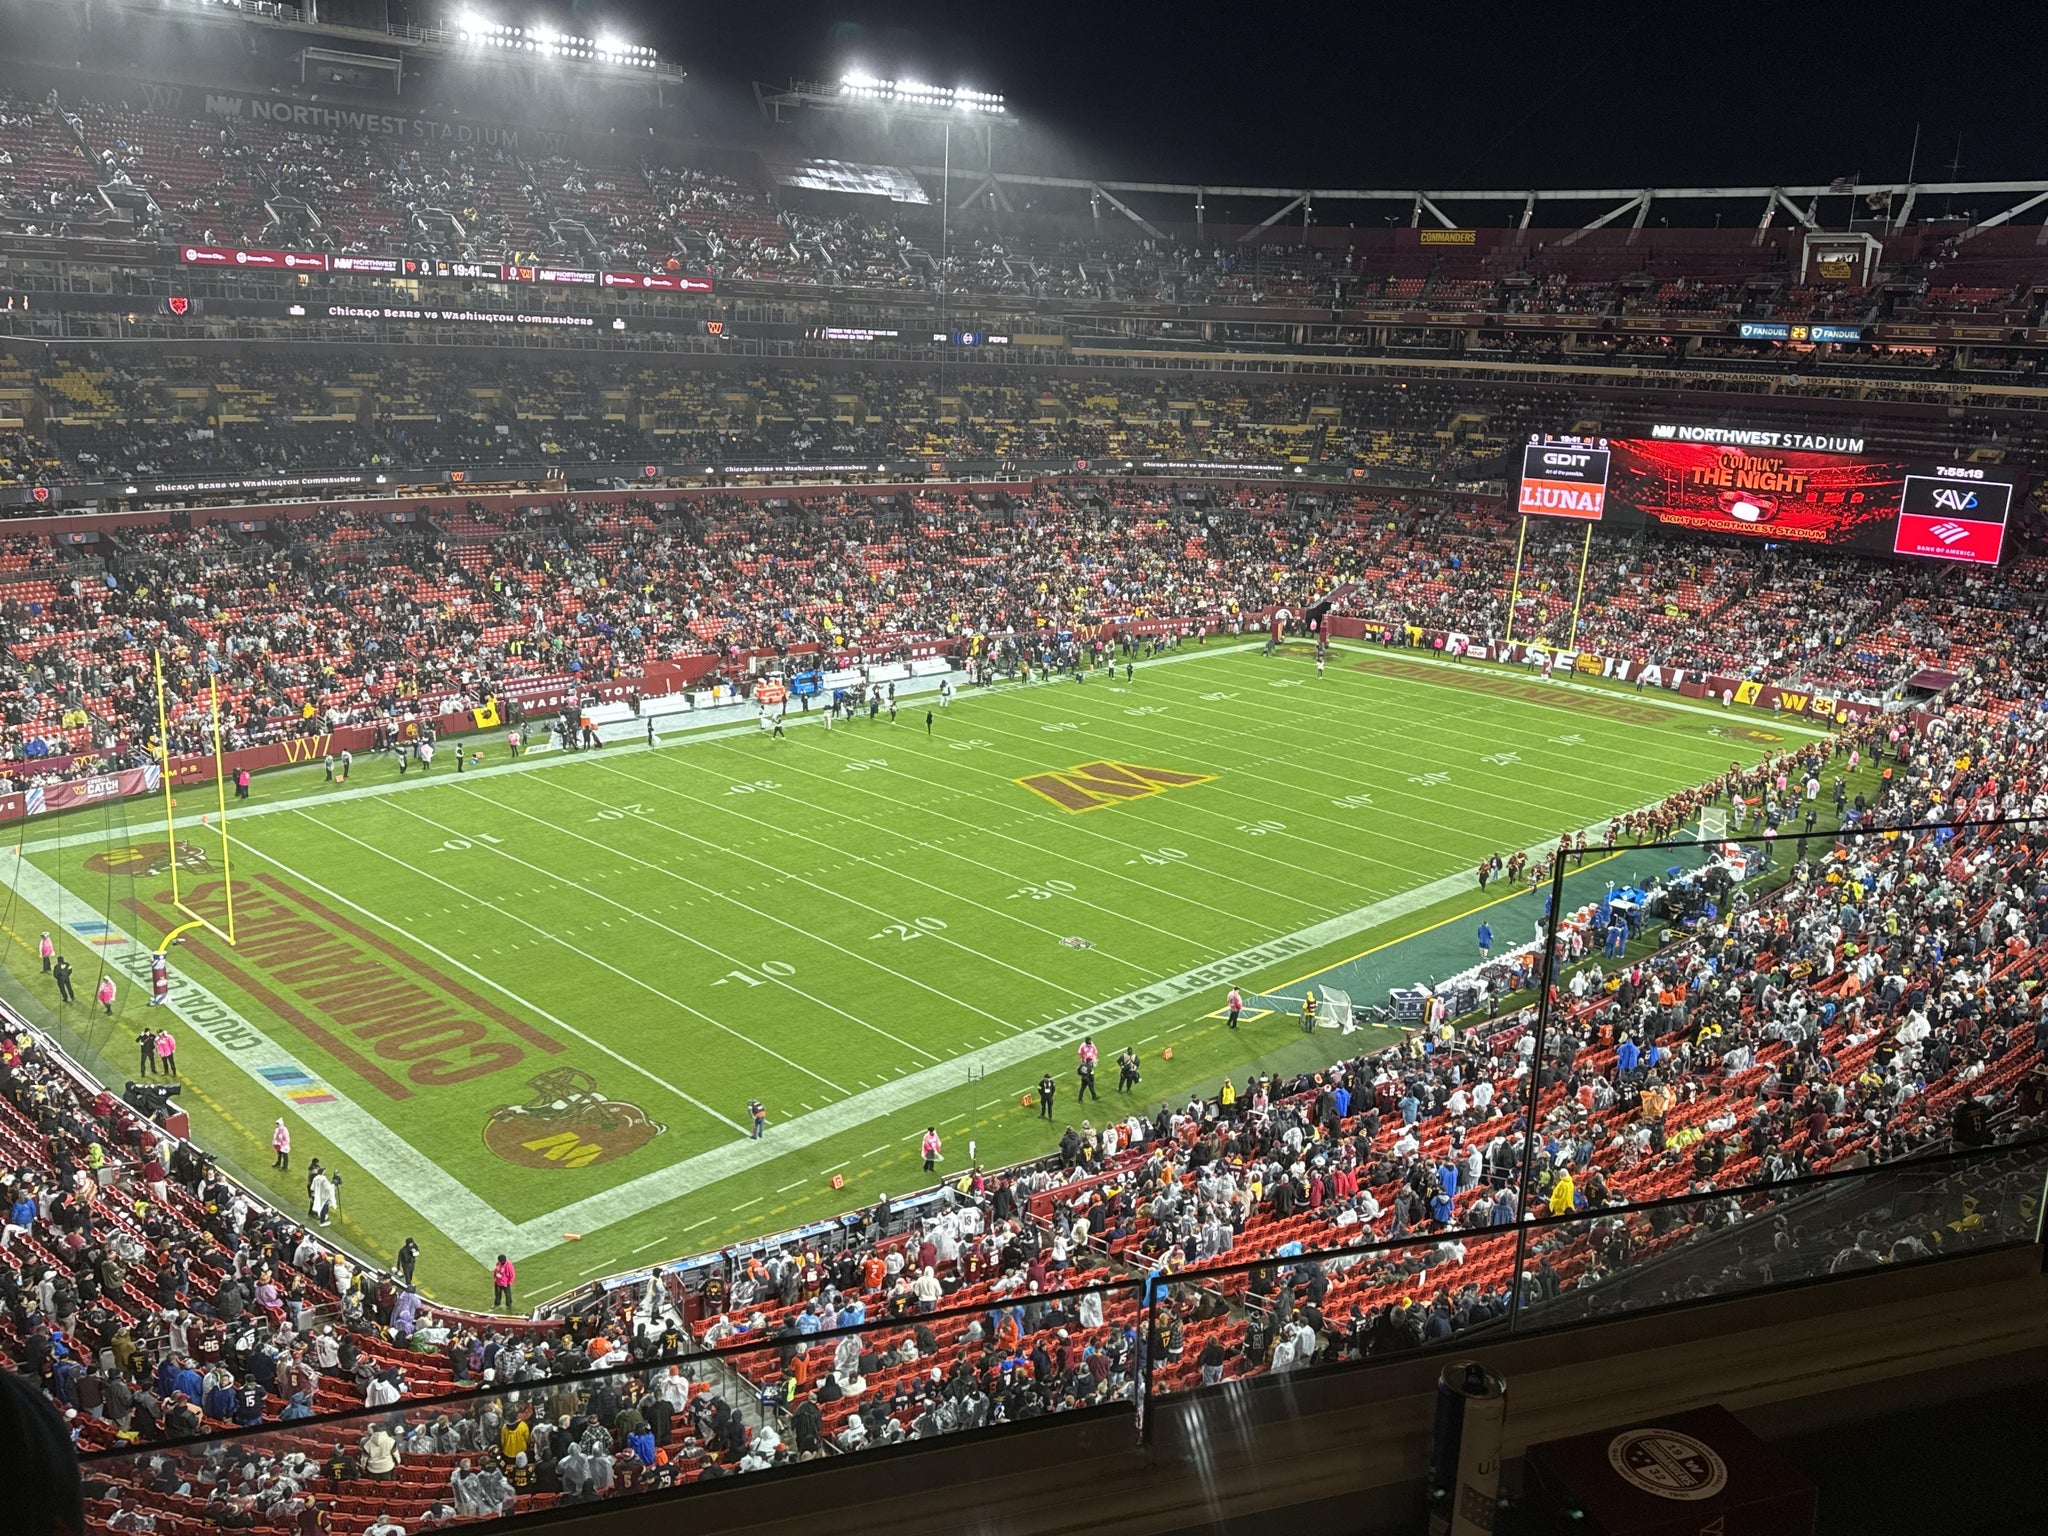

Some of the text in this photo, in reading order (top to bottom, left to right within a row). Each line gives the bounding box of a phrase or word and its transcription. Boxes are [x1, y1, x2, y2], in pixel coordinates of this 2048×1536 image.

[205, 94, 519, 148] NW NORTHWEST STADIUM
[1420, 232, 1476, 243] COMMANDERS
[353, 258, 397, 268] NORTHWEST
[421, 262, 430, 272] 0
[452, 264, 480, 277] 19:41
[509, 267, 517, 276] 0
[556, 272, 596, 280] NORTHWEST
[328, 306, 593, 326] Chicago Bears vs Washington Commanders
[1753, 327, 1788, 337] FANDUEL
[1792, 327, 1807, 338] 25
[1823, 329, 1860, 339] FANDUEL
[1674, 371, 1713, 379] WORLD
[1716, 373, 1782, 383] CHAMPIONS
[1805, 377, 1831, 385] 1937
[1839, 379, 1866, 387] 1942
[1910, 382, 1938, 390] 1987
[1947, 384, 1973, 392] 1991
[1531, 433, 1539, 442] 0
[1599, 438, 1608, 447] 0
[1652, 424, 1864, 453] NW NORTHWEST STADIUM
[1198, 462, 1237, 470] Washington
[1543, 452, 1591, 467] GDIT
[1718, 452, 1783, 475] Conquer
[724, 465, 752, 473] Chicago
[784, 464, 823, 472] Washington
[1936, 466, 1984, 479] 7:55:18
[155, 475, 361, 492] Chicago Bears vs Washington Commanders
[1691, 466, 1733, 487] THE
[1521, 486, 1602, 512] LiUNA!
[1660, 514, 1827, 540] LIGHT UP NORTHWEST STADIUM
[1917, 545, 1935, 553] BANK
[1945, 548, 1976, 557] AMERICA
[1354, 657, 1679, 724] COMMANDERS
[1123, 705, 1162, 717] 30
[1815, 699, 1833, 712] 25
[1040, 721, 1080, 733] 40
[948, 738, 993, 751] 50
[1547, 733, 1580, 746] 10
[846, 757, 889, 773] 40
[1481, 751, 1516, 766] 20
[1407, 771, 1446, 787] 30
[88, 780, 119, 794] CATCH
[730, 779, 783, 797] 30
[1331, 791, 1368, 810] 40
[595, 803, 656, 821] 20
[1236, 819, 1288, 837] 50
[442, 831, 505, 852] 10
[1137, 846, 1190, 867] 40
[1018, 877, 1078, 901] 30
[881, 915, 948, 942] 20
[724, 959, 797, 989] 10
[154, 879, 526, 1087] COMMANDERS
[1034, 937, 1313, 1043] INTERCEPT CANCER
[171, 988, 263, 1051] CRUCIAL
[204, 1340, 219, 1353] 26
[245, 1396, 255, 1407] 15
[1666, 1444, 1683, 1456] 19
[1649, 1468, 1666, 1481] 32
